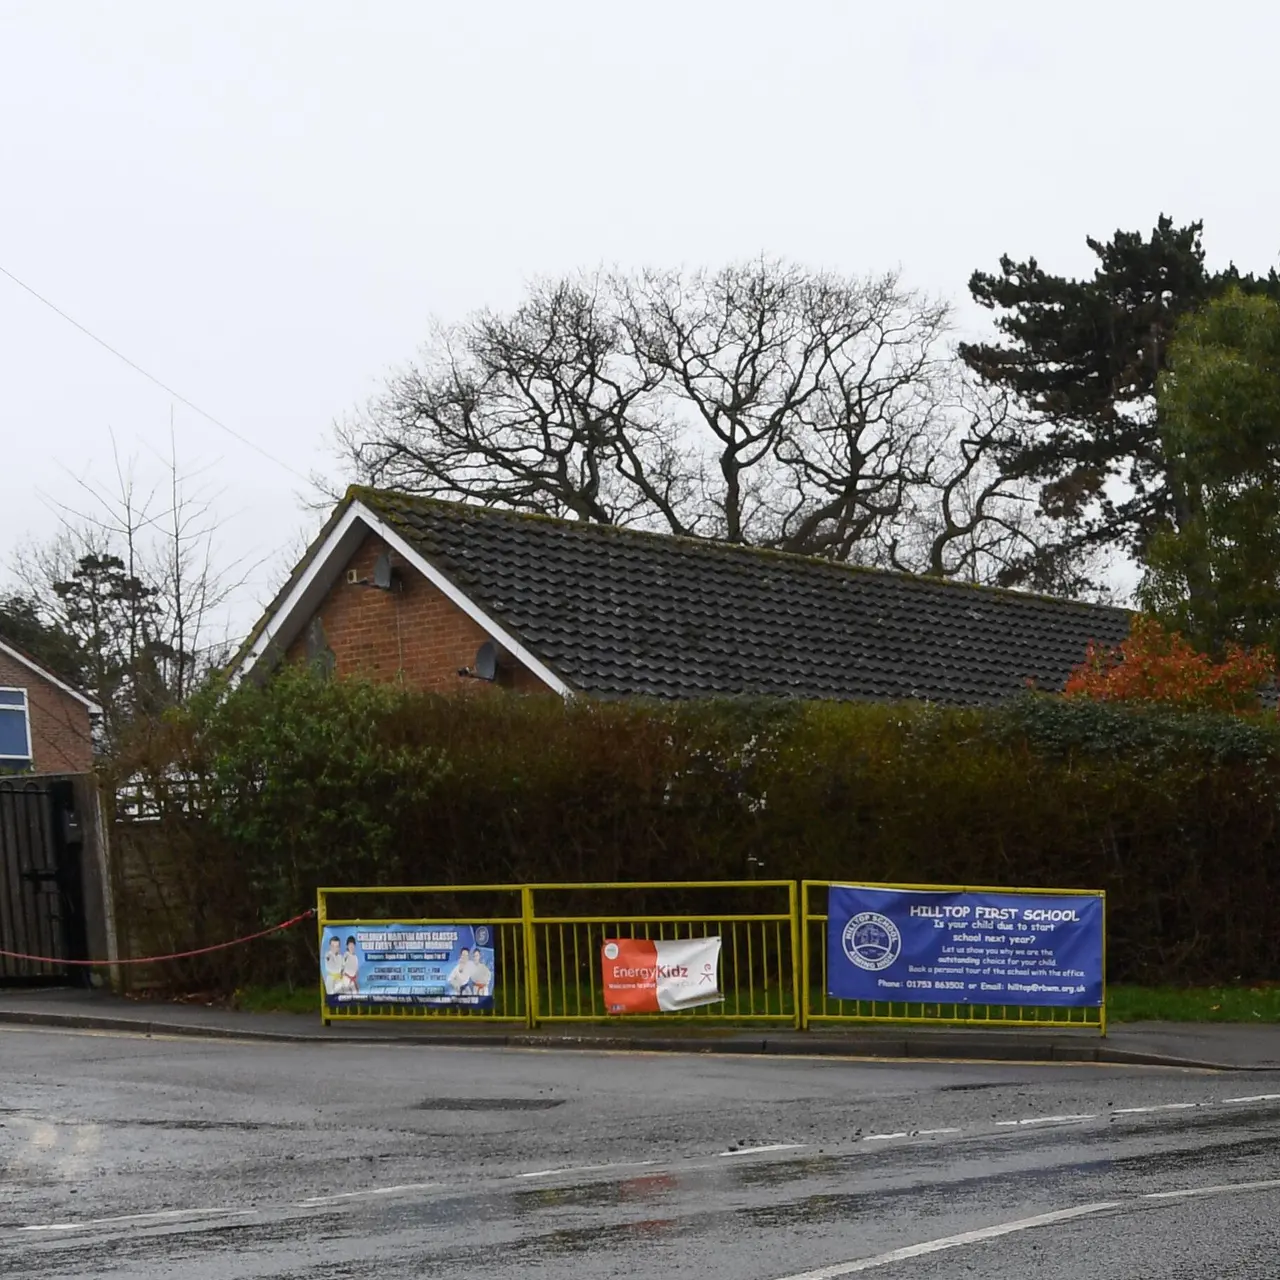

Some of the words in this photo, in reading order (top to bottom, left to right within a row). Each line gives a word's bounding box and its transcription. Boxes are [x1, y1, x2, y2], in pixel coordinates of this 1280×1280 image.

[910, 905, 970, 918] HILLTOP
[975, 906, 1019, 920] FIRST
[1023, 909, 1081, 922] SCHOOL
[846, 915, 870, 940] HILLTOP
[872, 915, 898, 942] SCHOOL
[933, 920, 945, 928] Is
[947, 921, 967, 930] your
[972, 921, 993, 930] child
[997, 921, 1014, 930] due
[1017, 922, 1028, 931] to
[1031, 923, 1056, 932] start
[953, 933, 982, 942] school
[985, 935, 1005, 943] next
[1009, 935, 1036, 945] year?
[1000, 948, 1014, 956] why
[937, 957, 980, 965] outstanding
[613, 965, 688, 981] EnergyKidz
[908, 965, 927, 973] Book
[933, 966, 964, 974] personal
[965, 966, 982, 974] tour
[1006, 968, 1030, 976] school
[877, 979, 903, 988] Phone:
[906, 980, 932, 988] 01753
[934, 981, 965, 989] 863502
[980, 982, 1004, 990] Email:
[1007, 983, 1086, 994] hilltop@rbwm.org.uk
